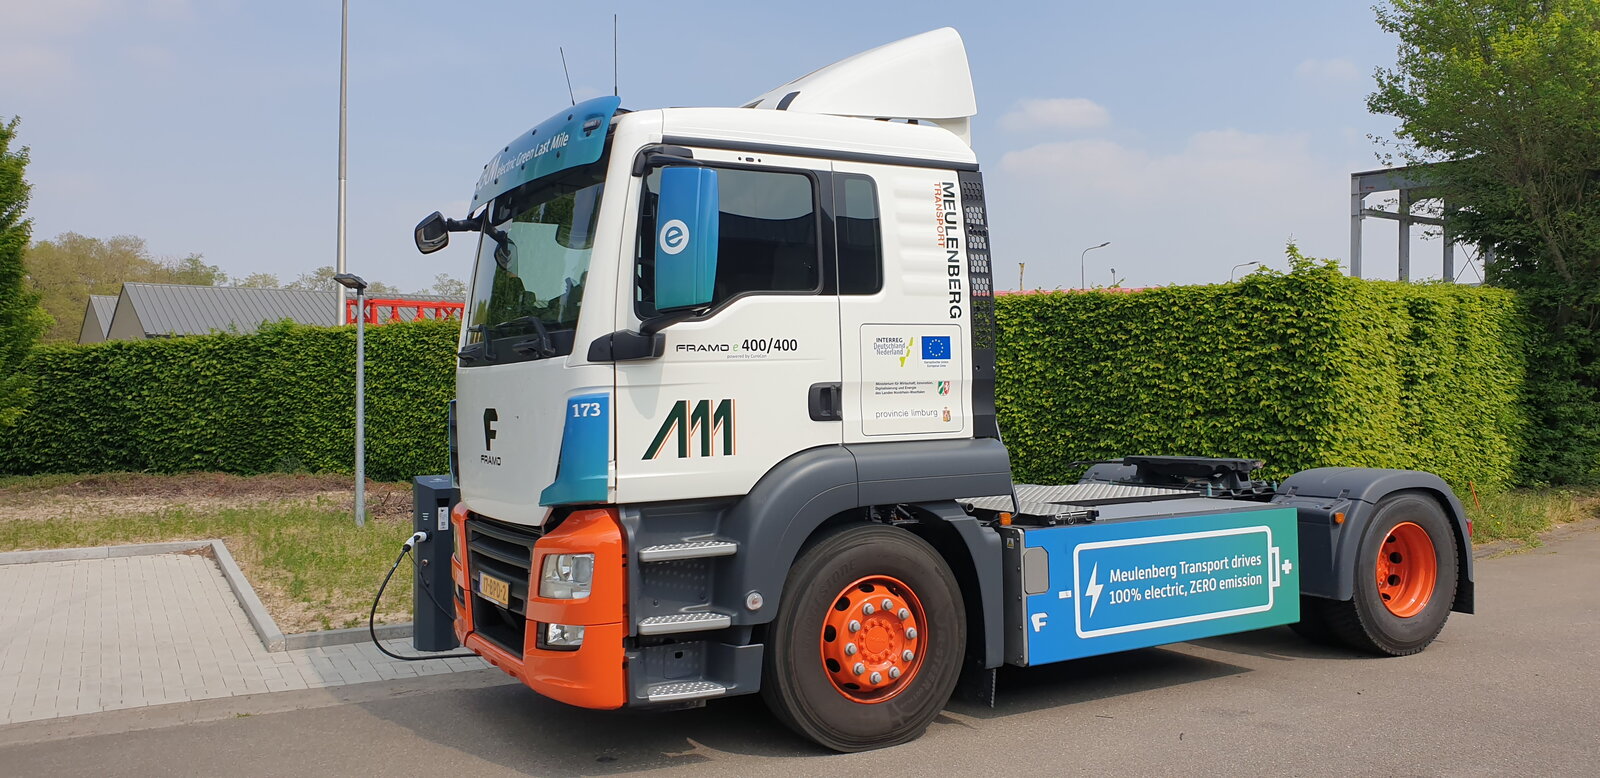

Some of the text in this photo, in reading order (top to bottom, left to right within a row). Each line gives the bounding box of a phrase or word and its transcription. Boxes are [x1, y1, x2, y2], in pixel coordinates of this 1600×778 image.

[516, 148, 534, 167] Green
[534, 139, 550, 158] Last
[550, 132, 569, 151] Mile
[934, 182, 945, 247] TRANSPORT
[942, 182, 962, 319] MEULENBERG
[676, 338, 798, 354] FRAMO e 400/400
[873, 342, 906, 350] Deutschland
[572, 403, 601, 418] 173
[875, 409, 938, 419] provincie limburg
[483, 408, 499, 451] F
[480, 454, 501, 466] FRAMO
[1110, 554, 1262, 583] Meulenberg Transport drives
[1109, 572, 1262, 605] 100% electric, ZERO emission
[1031, 612, 1048, 632] F
